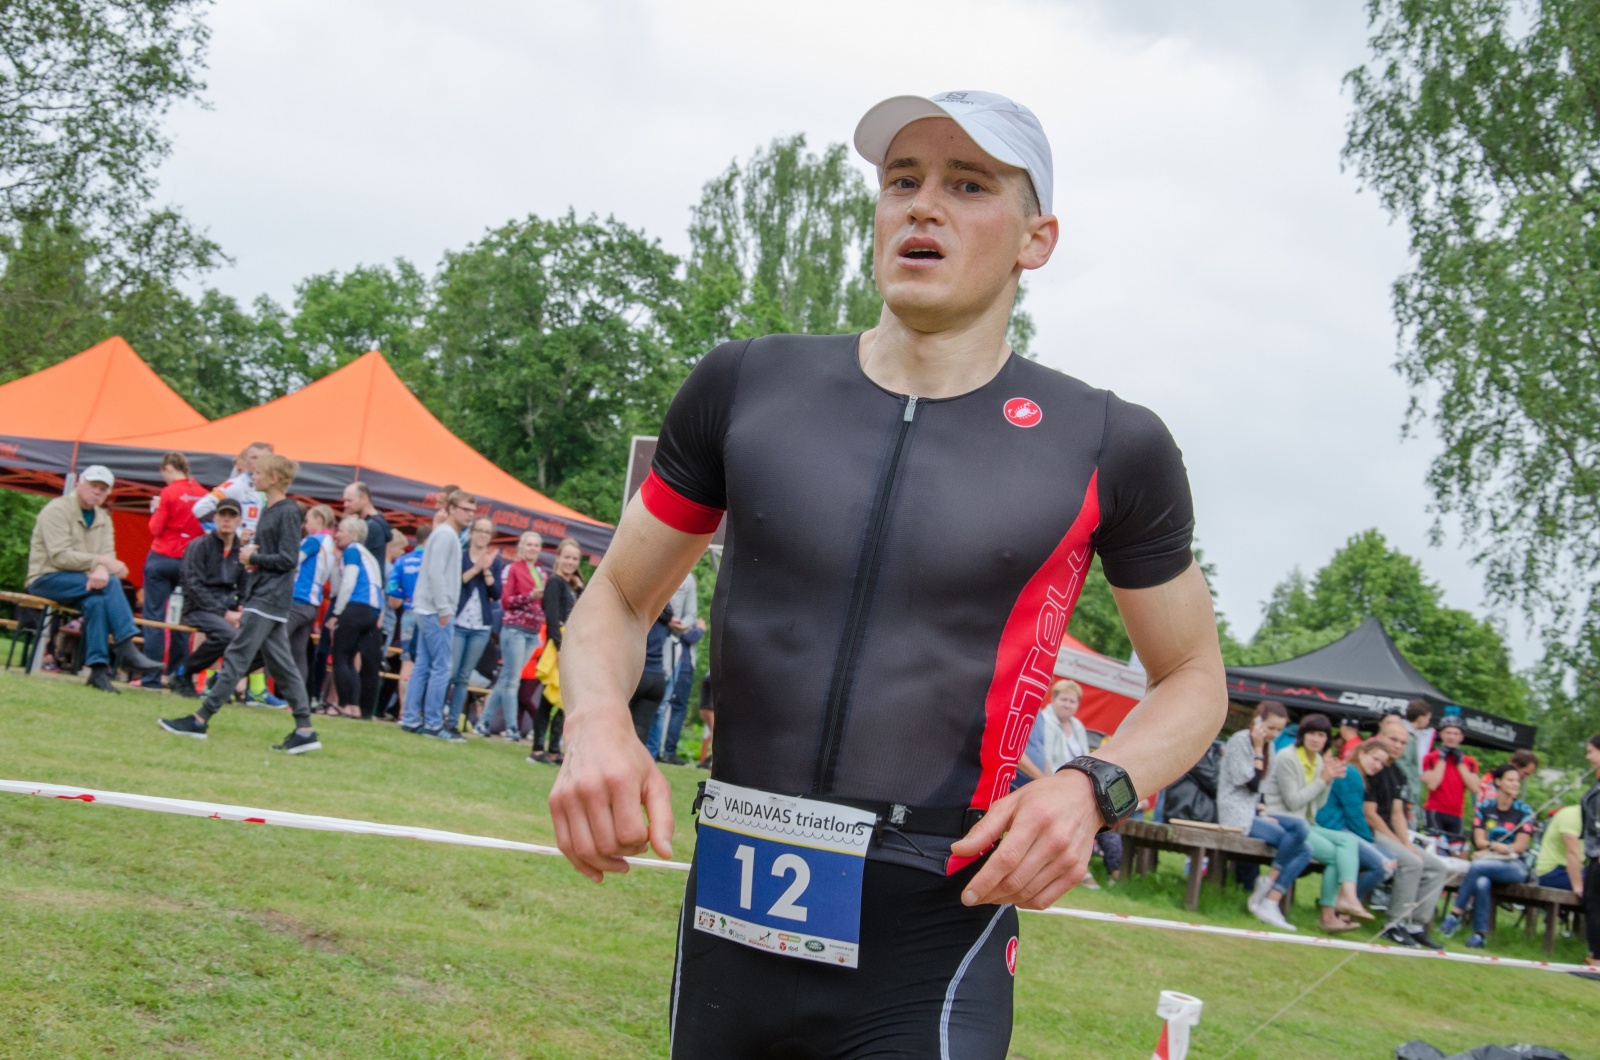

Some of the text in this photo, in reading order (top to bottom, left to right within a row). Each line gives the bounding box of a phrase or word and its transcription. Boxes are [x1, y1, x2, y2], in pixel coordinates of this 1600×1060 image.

[724, 797, 866, 836] VAIDAVAS triatlons
[734, 844, 811, 923] 12
